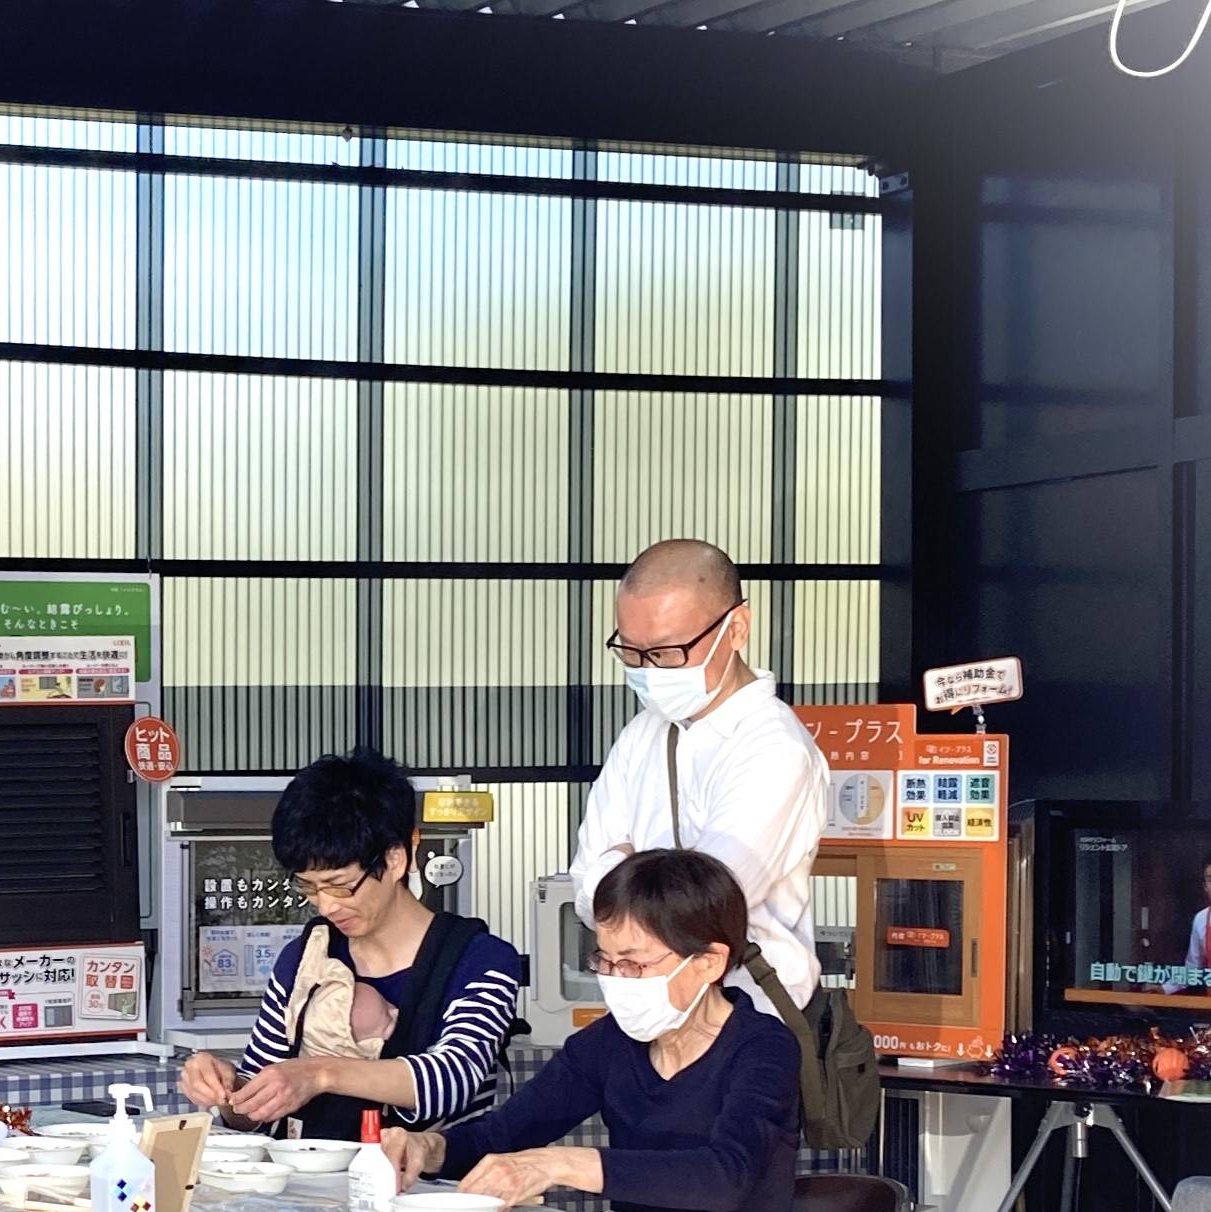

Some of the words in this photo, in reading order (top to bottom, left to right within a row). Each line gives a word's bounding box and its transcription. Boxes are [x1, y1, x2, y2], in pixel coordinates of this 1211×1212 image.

[135, 726, 170, 743] ヒット
[907, 812, 924, 822] UV
[87, 959, 136, 975] カンタン
